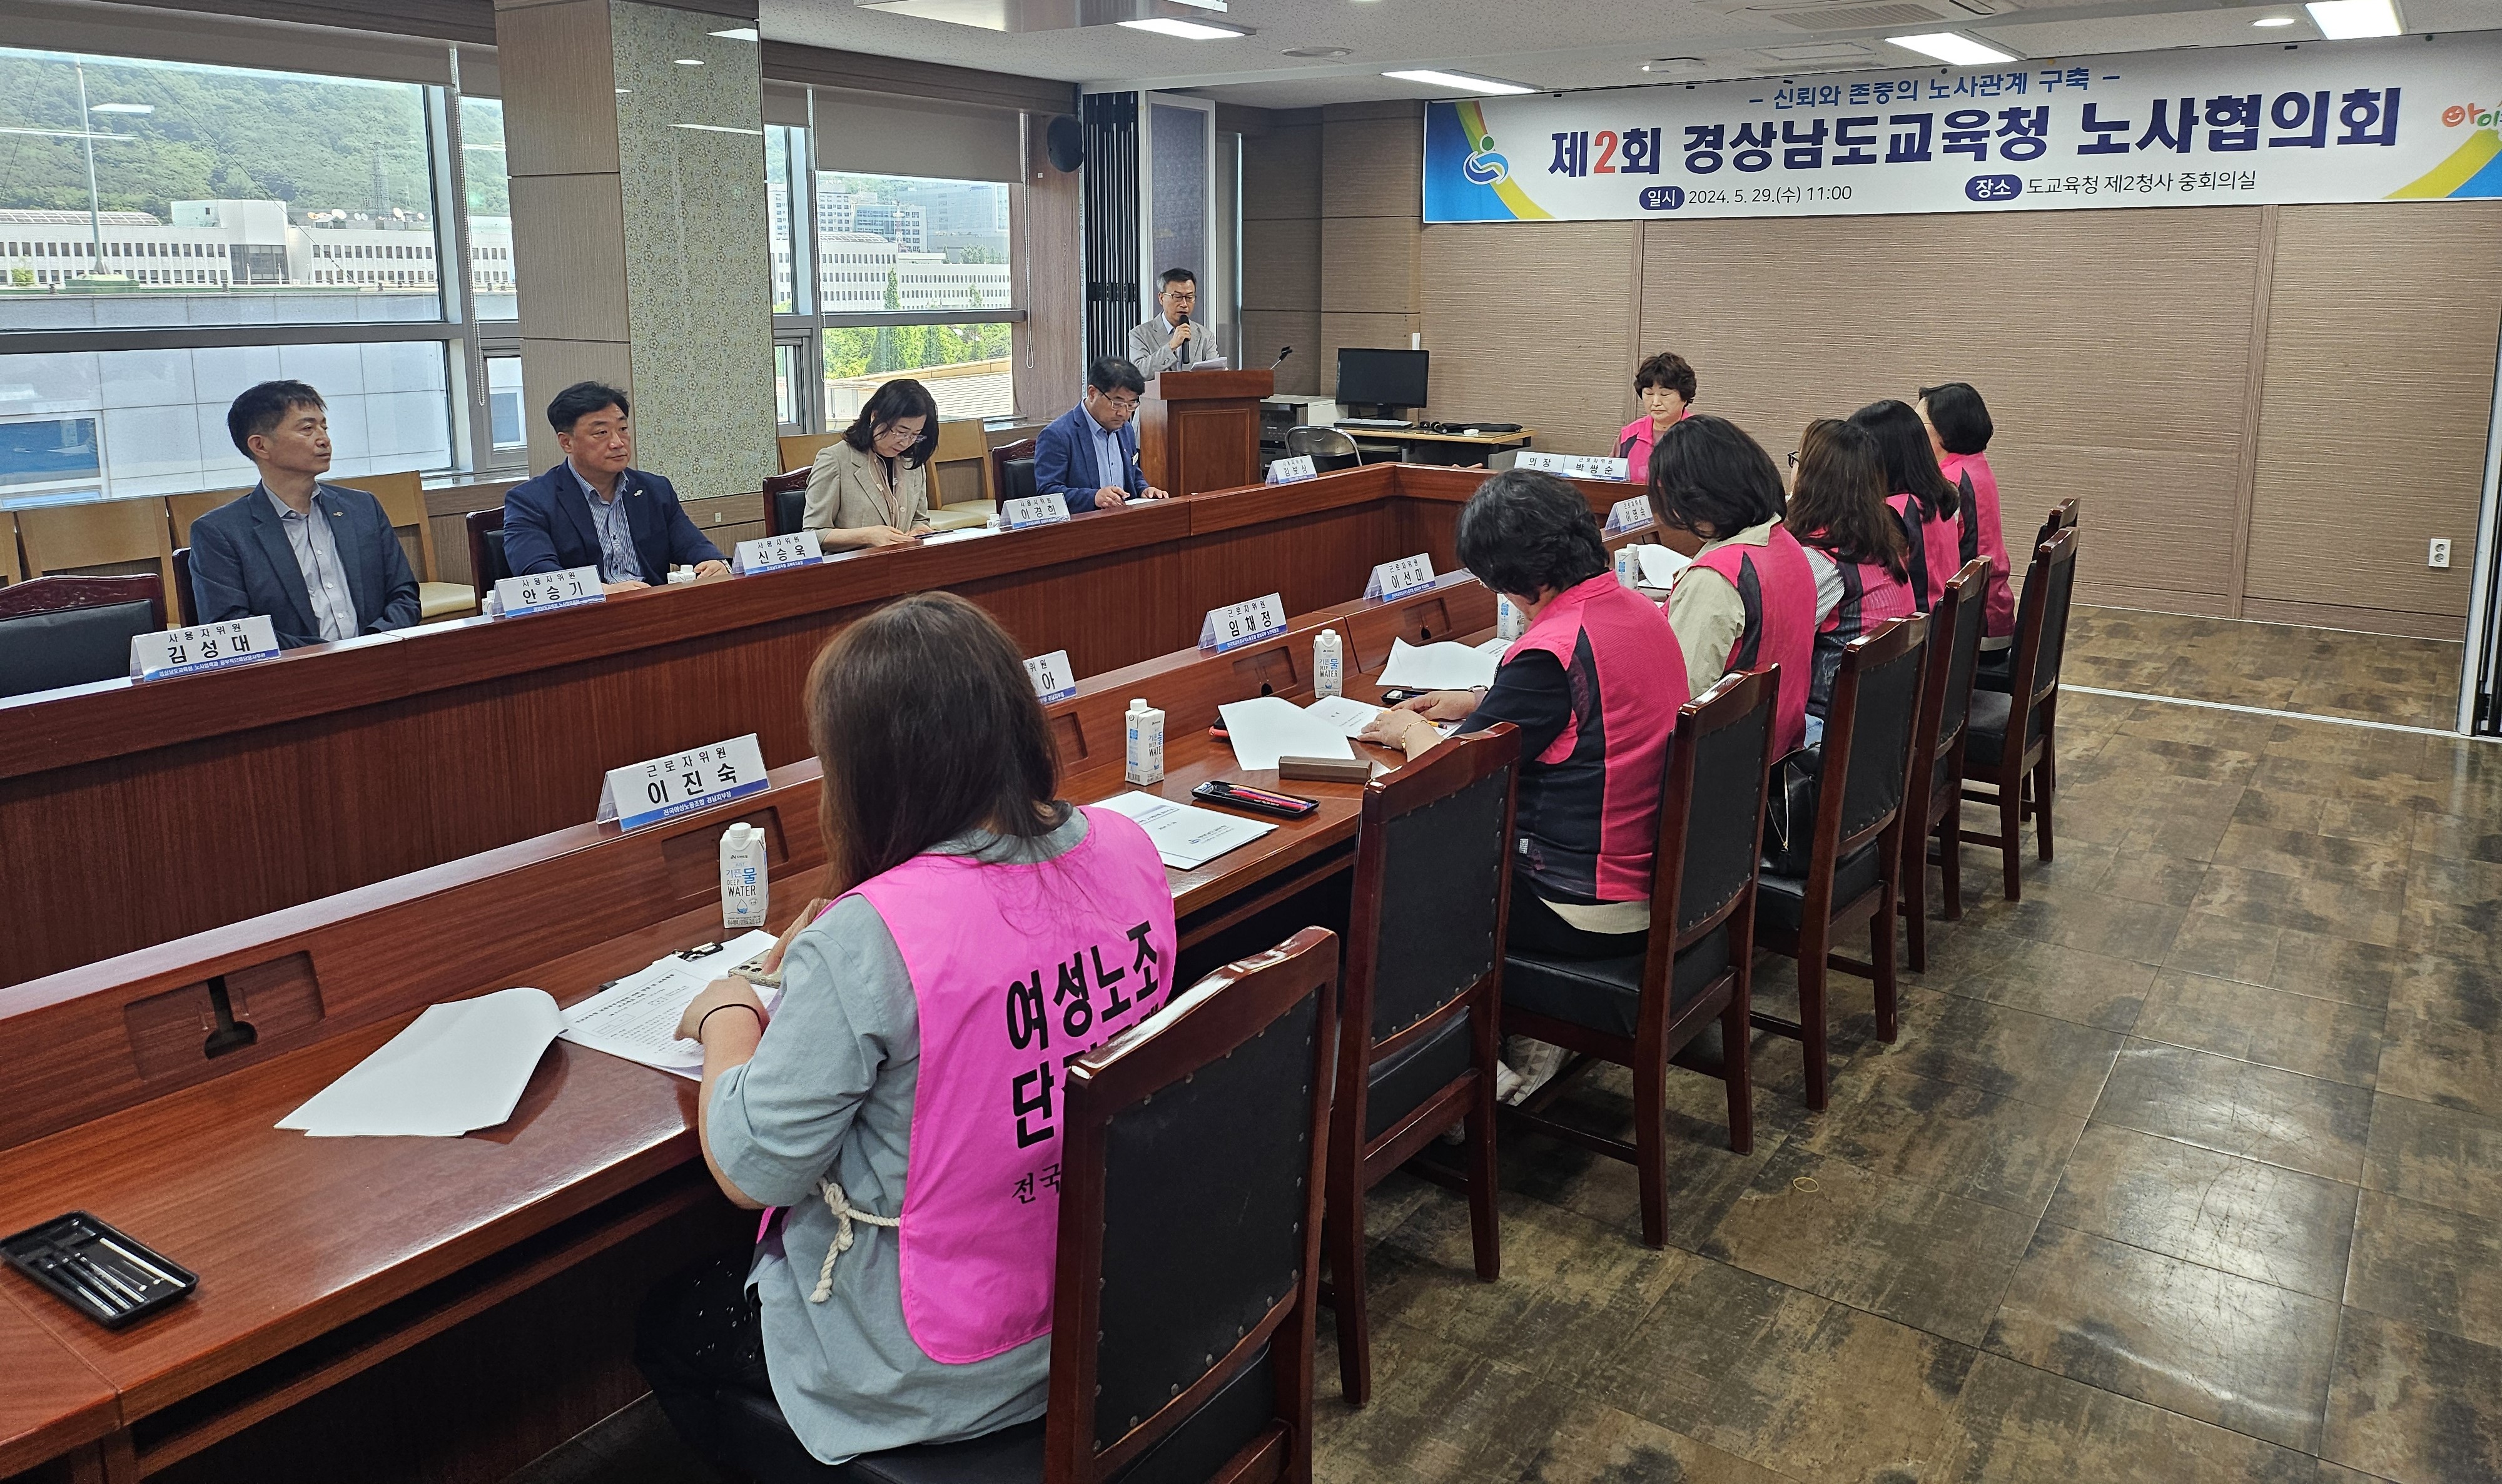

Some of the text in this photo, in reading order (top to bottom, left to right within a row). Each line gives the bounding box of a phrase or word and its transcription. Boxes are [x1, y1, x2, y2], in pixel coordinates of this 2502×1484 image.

[1774, 86, 1841, 109] 신뢰와
[1848, 81, 1918, 106] 존중의
[1928, 71, 2027, 100] 노사관계
[2039, 67, 2090, 92] 구축
[1548, 88, 2401, 179] 제2회 경상남도교육청 노사협의회
[1974, 170, 2256, 198] 장소 도교육청 제2청사 중회의실
[1647, 186, 1853, 207] 일시 2024. 5. 29.(수) 11:00
[1528, 457, 1551, 467] 의장
[1021, 505, 1056, 520] 이경희
[757, 536, 799, 549] 사용자위원
[758, 545, 806, 565] 신승욱
[522, 572, 576, 587] 사용자위원
[1391, 568, 1424, 588] 이선미
[523, 582, 584, 605] 안승기
[1227, 600, 1266, 618] 근로자위원
[168, 623, 242, 643] 사용자위원
[1229, 610, 1272, 637] 임채정
[167, 634, 251, 664] 김성대
[1320, 670, 1338, 678] WATER
[1148, 745, 1163, 757] WATE
[646, 747, 726, 777] 근로자위원
[647, 763, 737, 805] 이진숙
[728, 886, 756, 897] WATER
[1006, 921, 1158, 1051] 여성노조
